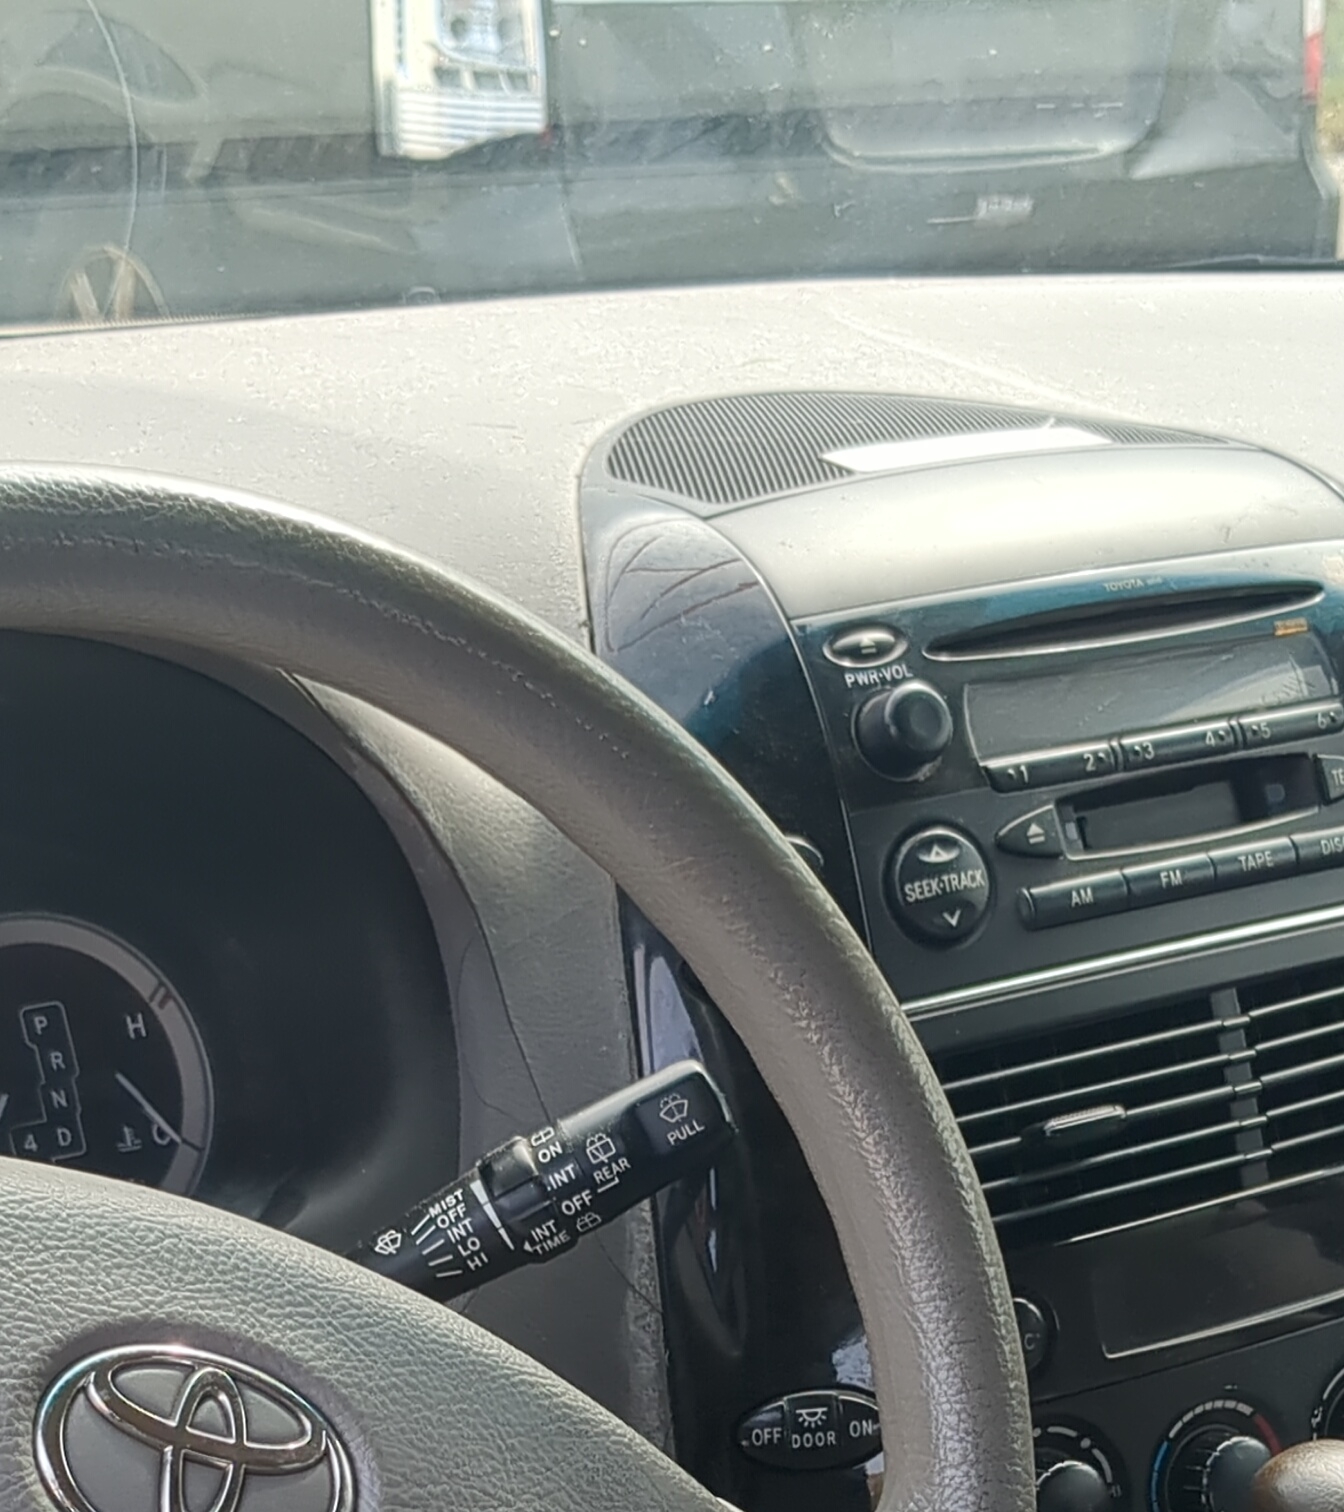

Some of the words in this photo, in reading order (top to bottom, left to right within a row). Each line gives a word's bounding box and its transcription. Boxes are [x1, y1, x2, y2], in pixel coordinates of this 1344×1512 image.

[1259, 722, 1271, 739] 5
[1317, 711, 1328, 729] 6
[1205, 729, 1216, 747] 4
[1143, 742, 1155, 760] 3
[1083, 753, 1096, 772] 2
[1019, 765, 1029, 783] 1
[1238, 850, 1275, 872] TAPE
[1160, 868, 1184, 889] FM
[1071, 887, 1094, 908] AM
[33, 1015, 49, 1035] P
[126, 1011, 148, 1039] H
[49, 1050, 66, 1070] R
[50, 1089, 69, 1110] N
[23, 1133, 38, 1152] 4
[57, 1127, 73, 1147] D
[666, 1120, 707, 1147] PULL
[537, 1140, 564, 1165] ON
[548, 1163, 579, 1191] INT
[592, 1157, 632, 1185] REAR
[428, 1188, 465, 1218] MIST
[560, 1190, 594, 1217] OFF
[436, 1203, 468, 1230] OFF
[447, 1218, 474, 1244] INT
[529, 1219, 558, 1243] INT
[457, 1235, 481, 1257] LO
[532, 1231, 571, 1257] TIME
[467, 1253, 489, 1272] HI
[751, 1427, 783, 1446] OFF
[791, 1431, 837, 1449] DOOR
[849, 1418, 873, 1438] ON
